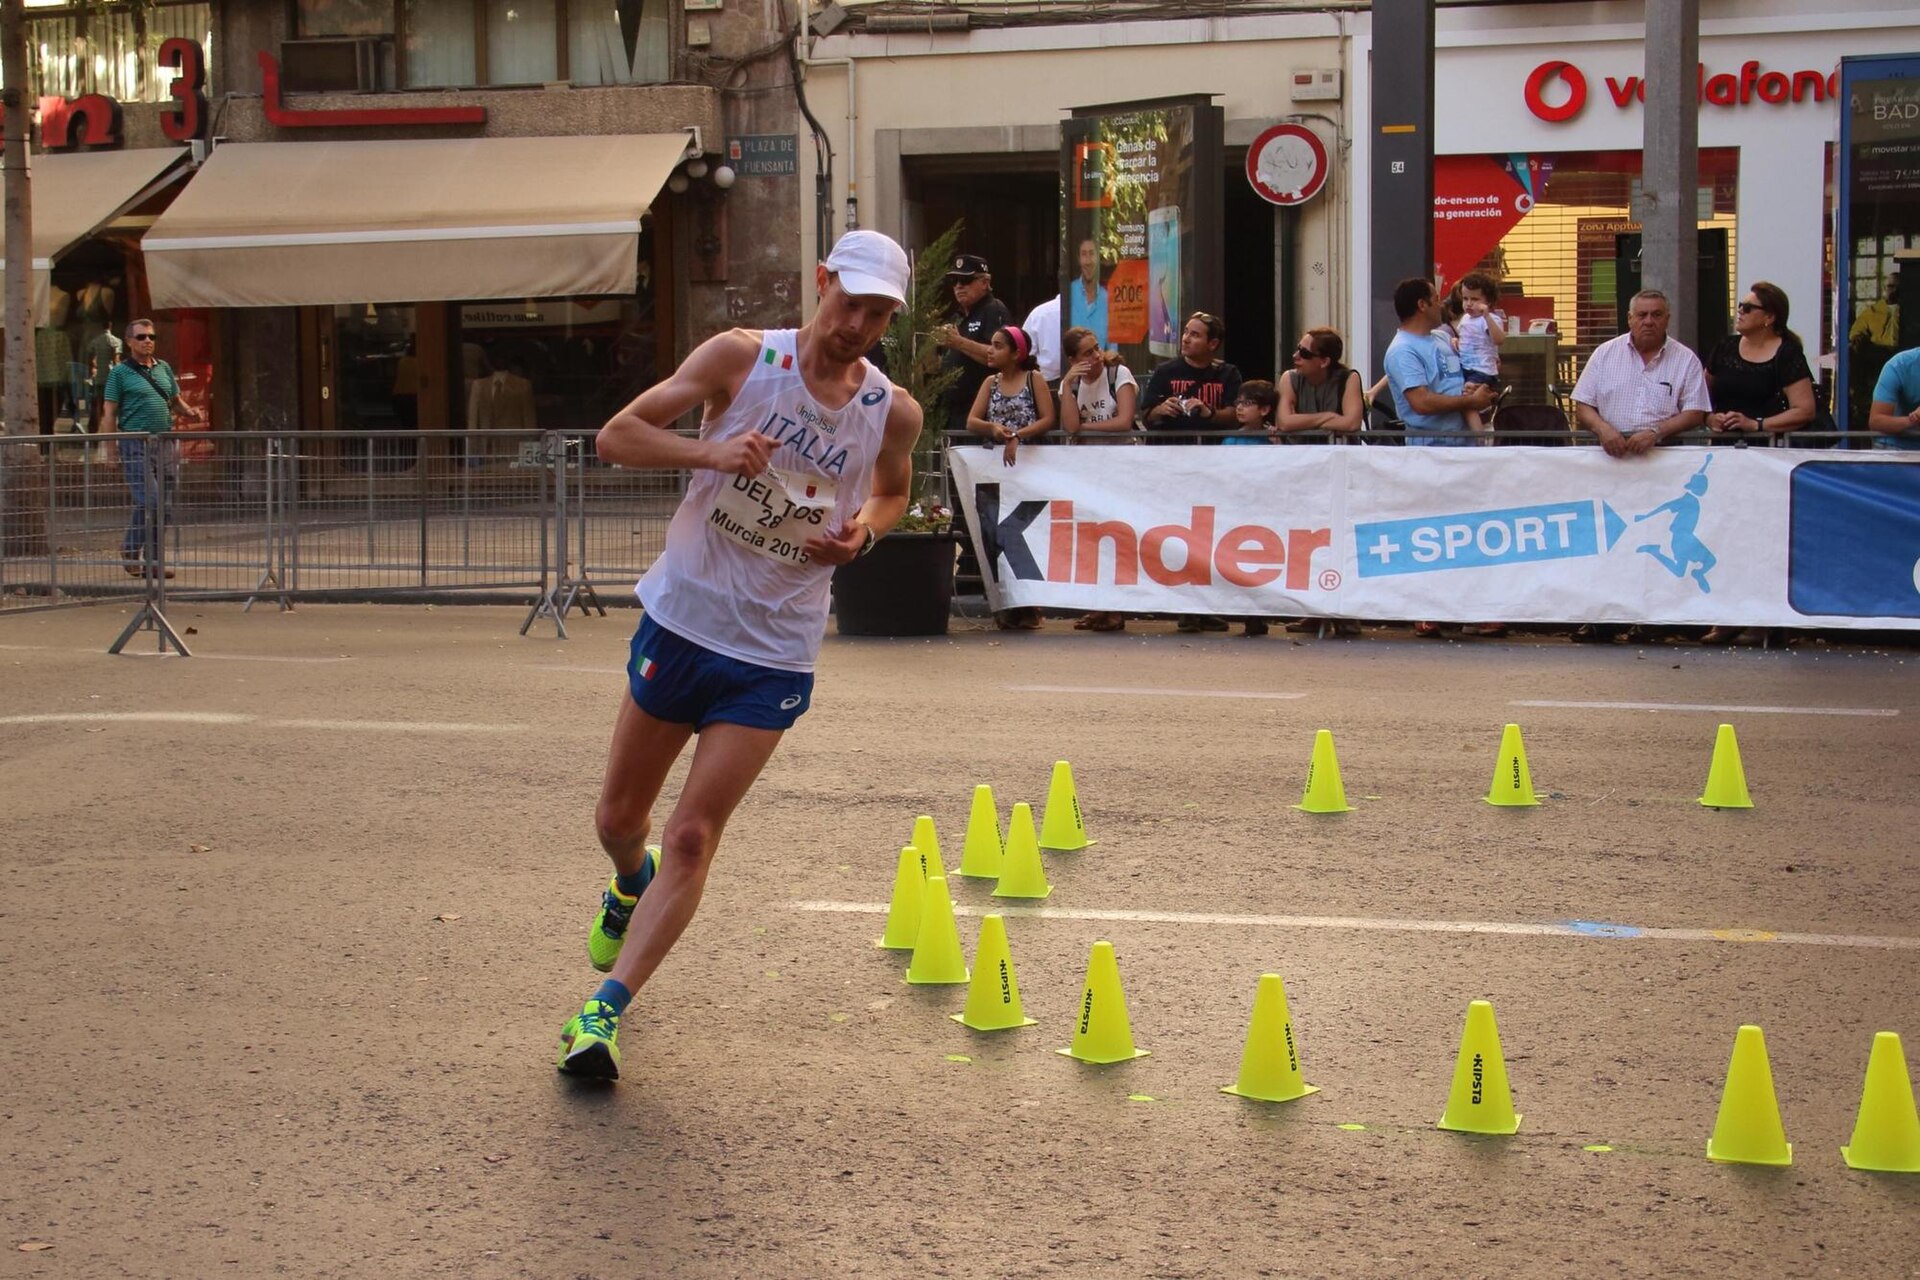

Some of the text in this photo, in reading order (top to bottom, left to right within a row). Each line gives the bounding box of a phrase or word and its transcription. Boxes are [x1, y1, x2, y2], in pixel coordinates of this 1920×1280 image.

[158, 37, 204, 140] 3
[1605, 60, 1838, 108] vafon
[1873, 104, 1919, 120] BAD
[744, 138, 794, 153] PLAZA DE
[1116, 138, 1157, 154] Ganas de
[1872, 145, 1908, 155] movistar
[744, 160, 795, 174] FUENSANTA
[1148, 154, 1157, 167] la
[1392, 162, 1404, 173] 54
[1486, 194, 1499, 204] de
[1446, 207, 1502, 220] generación
[1580, 222, 1604, 232] Zona
[1114, 285, 1144, 303] 200€
[761, 412, 848, 475] ITALIA
[756, 508, 783, 529] 28
[782, 498, 825, 526] TOS
[711, 507, 810, 564] Murcia 2015
[1411, 511, 1580, 566] SPORT
